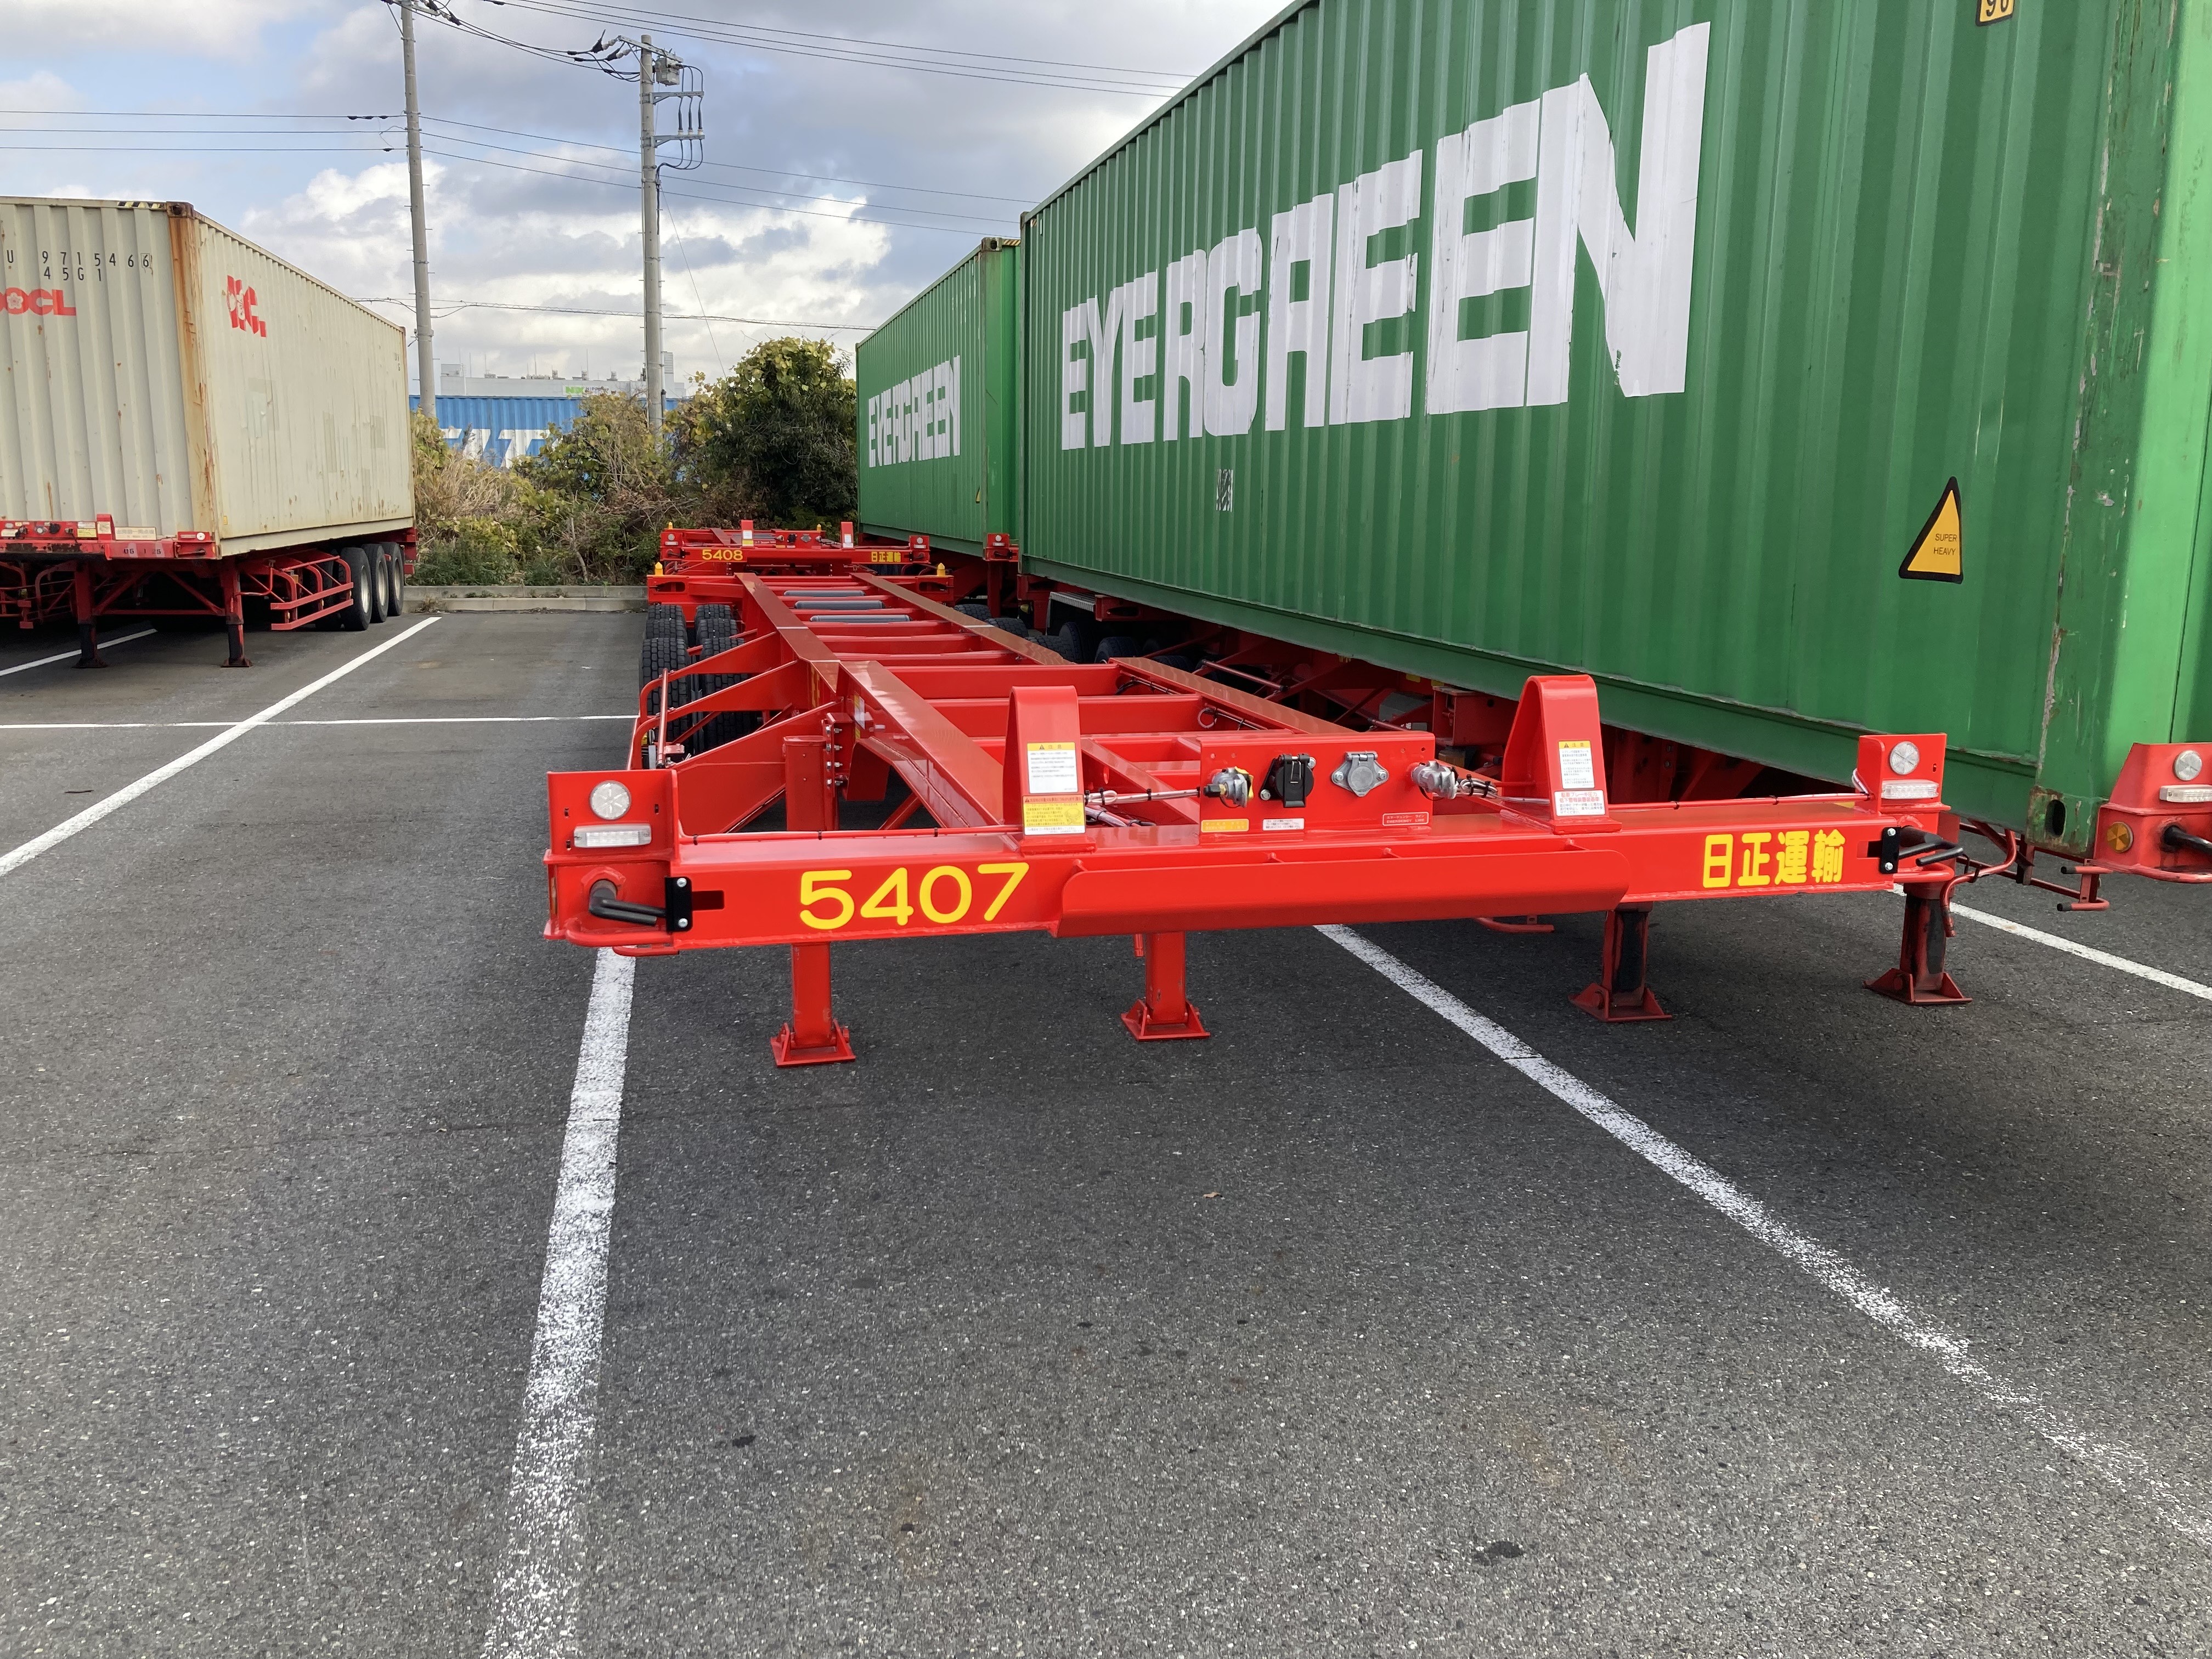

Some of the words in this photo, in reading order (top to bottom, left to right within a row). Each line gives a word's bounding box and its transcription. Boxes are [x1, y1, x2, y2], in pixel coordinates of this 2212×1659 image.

[1062, 21, 1711, 450] EVERGREEN
[0, 287, 76, 316] OCL
[869, 355, 960, 467] EVERGREEN
[702, 549, 743, 561] 5408
[1933, 547, 1956, 556] HEAVY
[1935, 533, 1957, 542] SUPER
[1702, 829, 1846, 888] 日正運輸
[800, 862, 1030, 930] 5407
